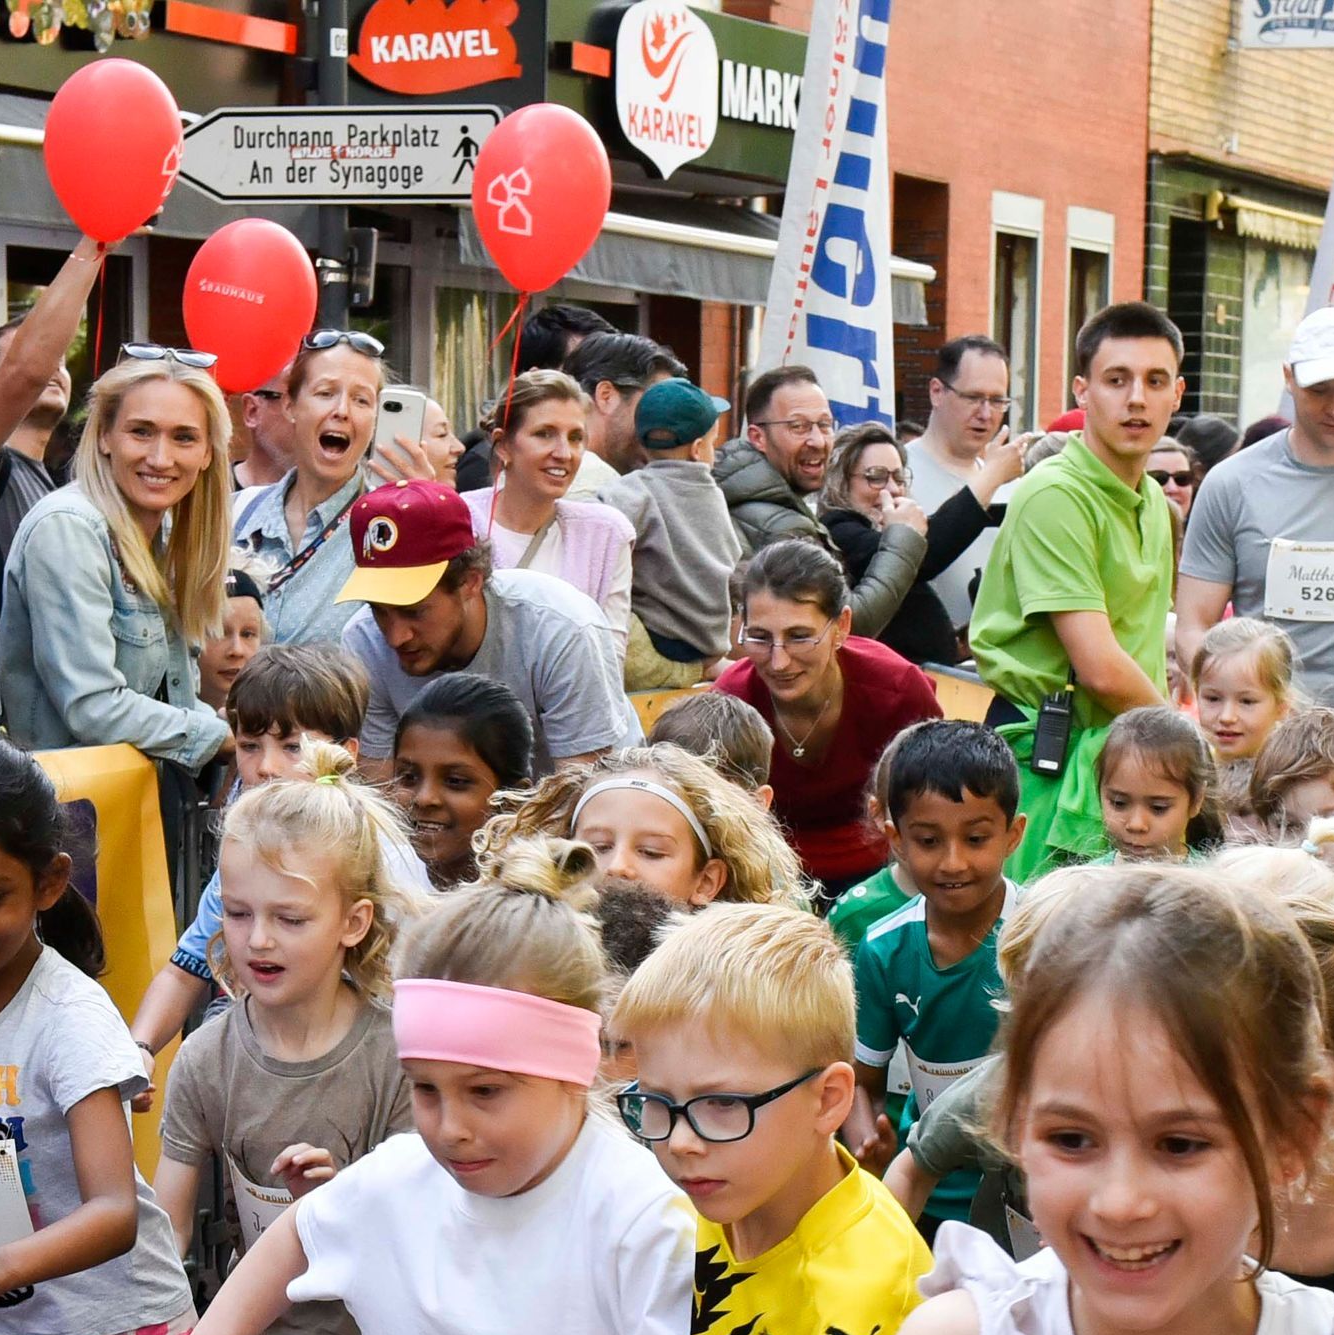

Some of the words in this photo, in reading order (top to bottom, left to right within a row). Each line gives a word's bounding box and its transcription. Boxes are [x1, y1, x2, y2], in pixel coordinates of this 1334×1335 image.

[370, 29, 499, 64] KARAYEL
[721, 59, 804, 130] MARK
[233, 124, 333, 150] Durchgang
[347, 123, 440, 149] Parkplatz
[628, 102, 707, 150] KARAYEL
[249, 160, 273, 184] An
[286, 158, 317, 184] der
[329, 160, 424, 189] Synagoge
[207, 282, 265, 304] BAUHAUS
